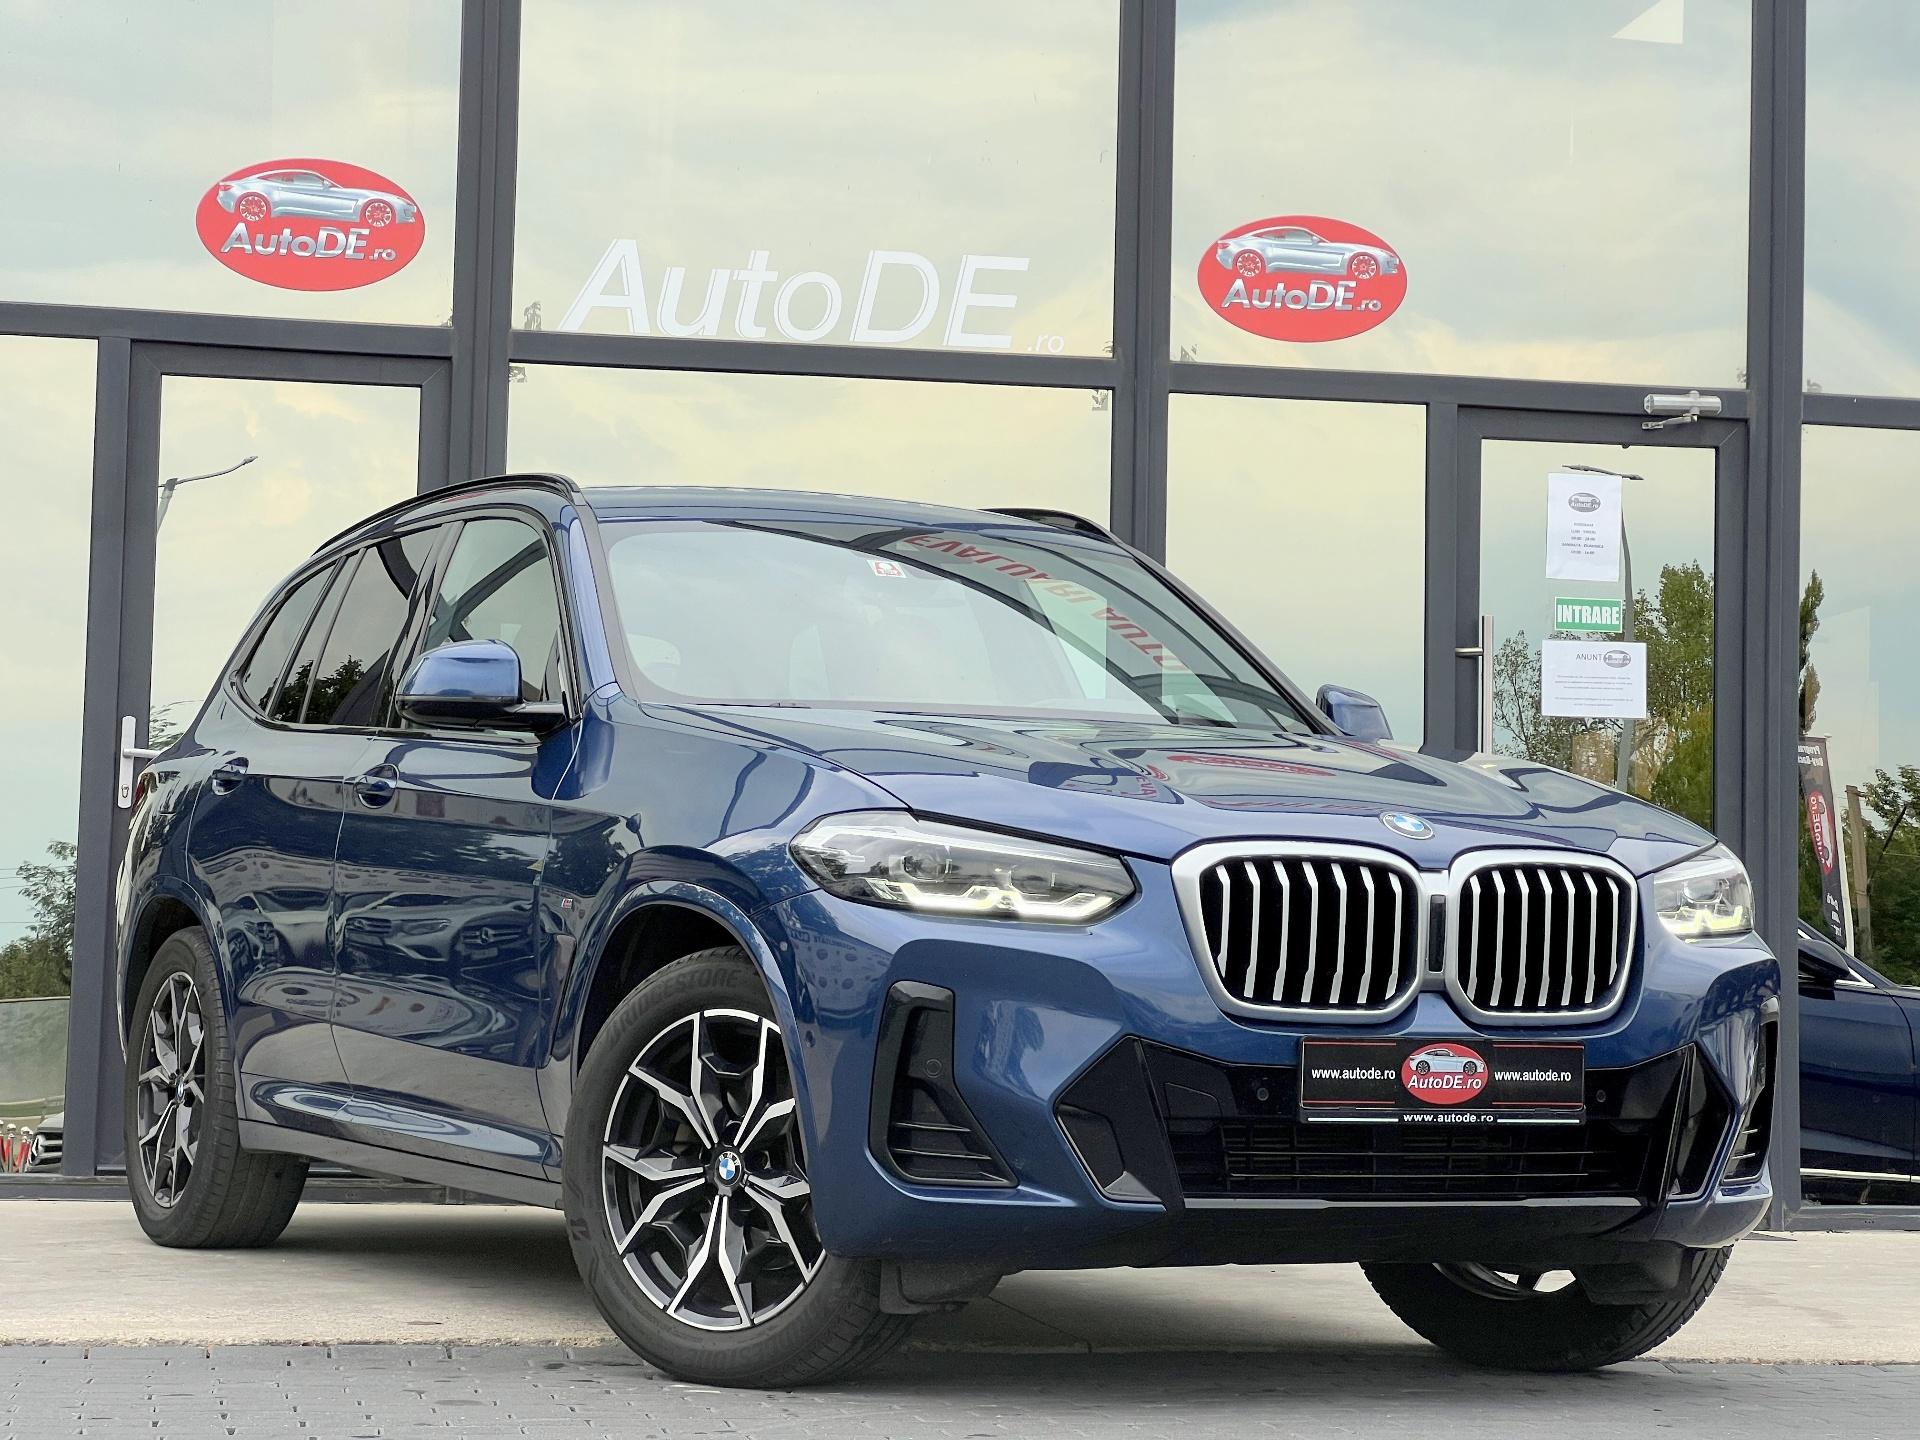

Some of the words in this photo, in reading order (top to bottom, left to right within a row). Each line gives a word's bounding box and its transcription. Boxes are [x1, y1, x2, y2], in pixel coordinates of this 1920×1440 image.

[1557, 604, 1620, 625] INTRARE
[1311, 1067, 1396, 1081] www.autode.ro
[1494, 1069, 1572, 1082] www.autode.ro
[1407, 1074, 1483, 1090] AutoDE.ro
[1403, 1112, 1494, 1123] www.autode.ro
